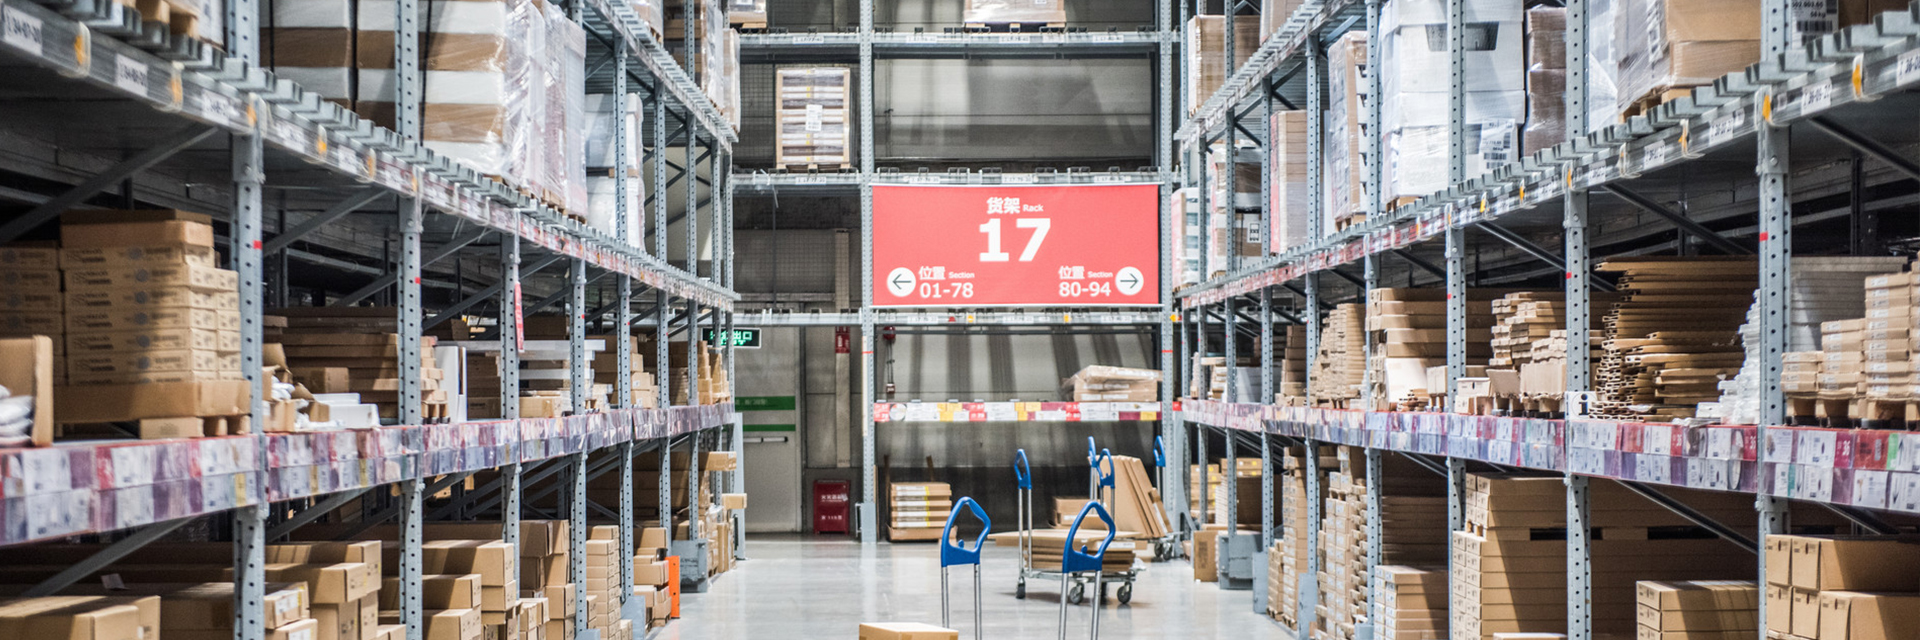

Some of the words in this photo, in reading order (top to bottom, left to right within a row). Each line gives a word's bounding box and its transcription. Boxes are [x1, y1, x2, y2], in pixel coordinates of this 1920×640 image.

[987, 197, 1020, 214] 货架
[1023, 204, 1043, 212] Rack
[979, 218, 1051, 262] 17
[918, 266, 945, 280] 位置
[948, 271, 975, 279] Section
[1058, 266, 1085, 279] 位置
[1088, 271, 1113, 279] Section
[920, 282, 974, 298] 01-78
[1059, 281, 1112, 297] 80-94
